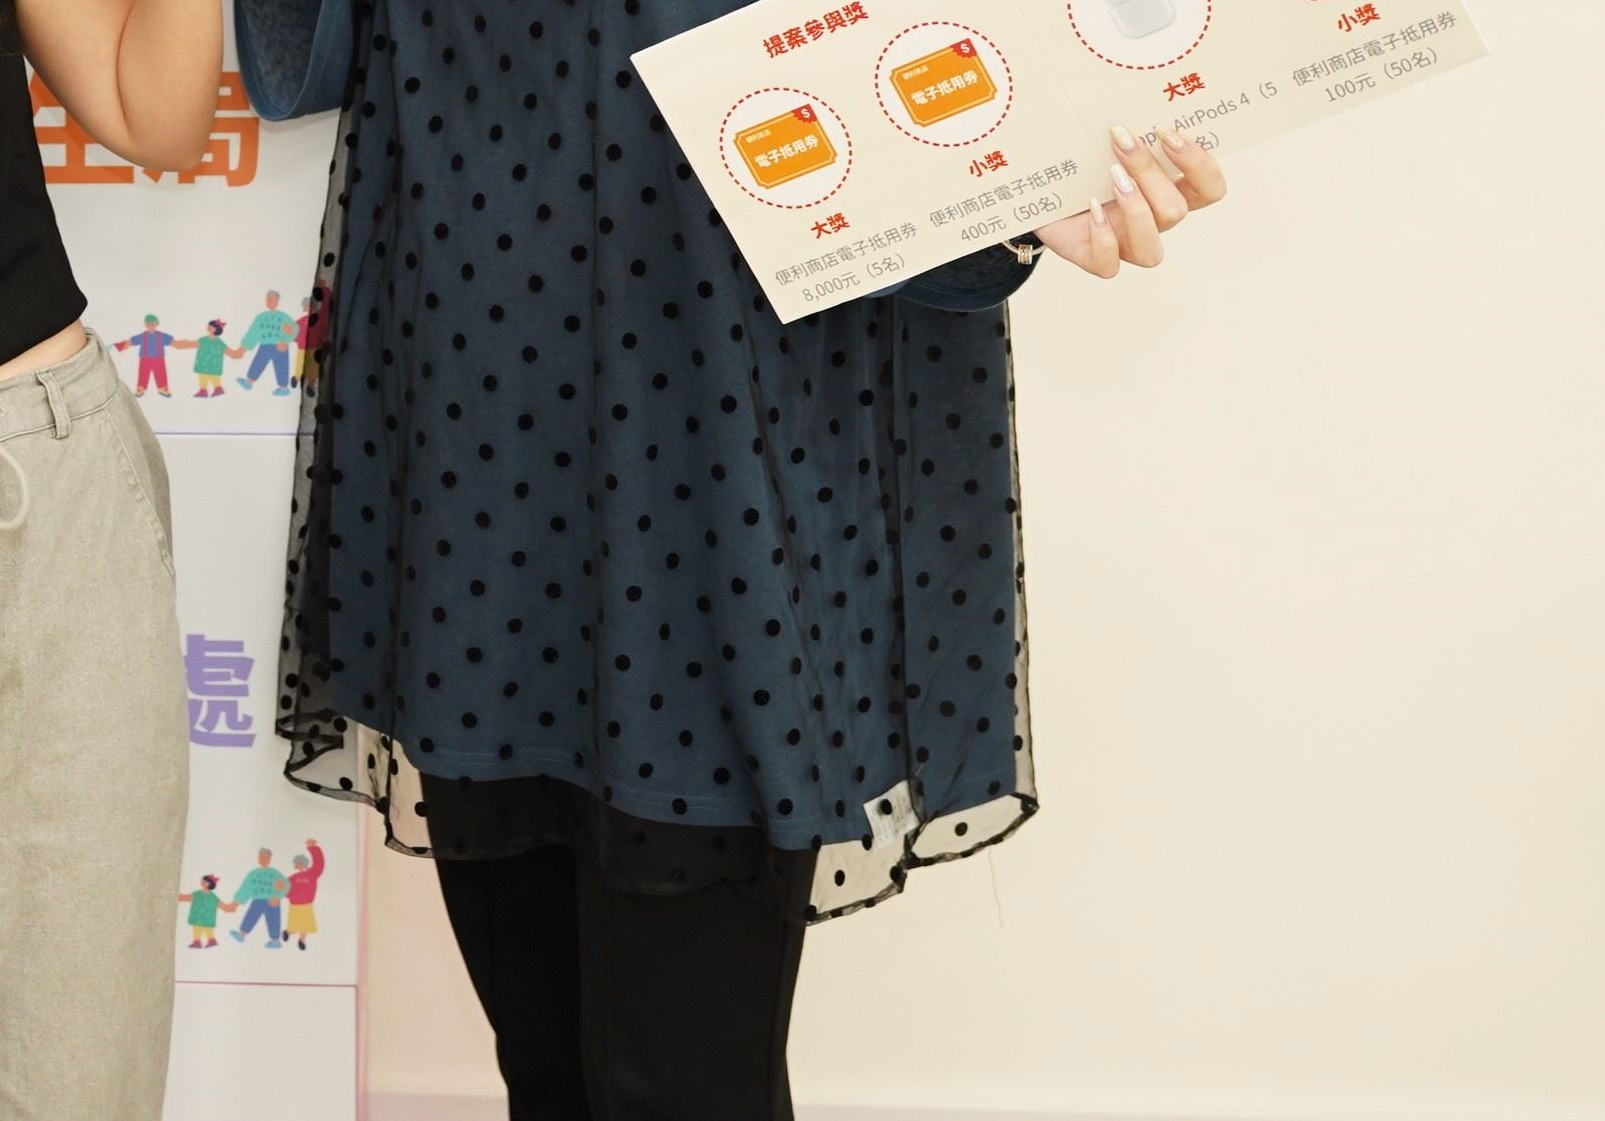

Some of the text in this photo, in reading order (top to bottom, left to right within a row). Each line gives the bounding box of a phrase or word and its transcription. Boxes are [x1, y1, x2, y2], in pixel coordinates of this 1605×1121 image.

[762, 1, 869, 58] 提案參與獎
[1336, 2, 1381, 33] 小獎
[1292, 10, 1457, 87] 便利商店電子抵用券
[910, 69, 979, 106] 電子抵用券
[1162, 72, 1206, 102] 大獎
[1173, 99, 1238, 133] AirPods
[754, 134, 819, 167] 電子抵用券
[968, 150, 1009, 178] 小獎
[928, 158, 1079, 228] 便利商店電子抵用券
[810, 212, 851, 240] 大獎
[774, 221, 917, 287] 便利商店電子抵用券
